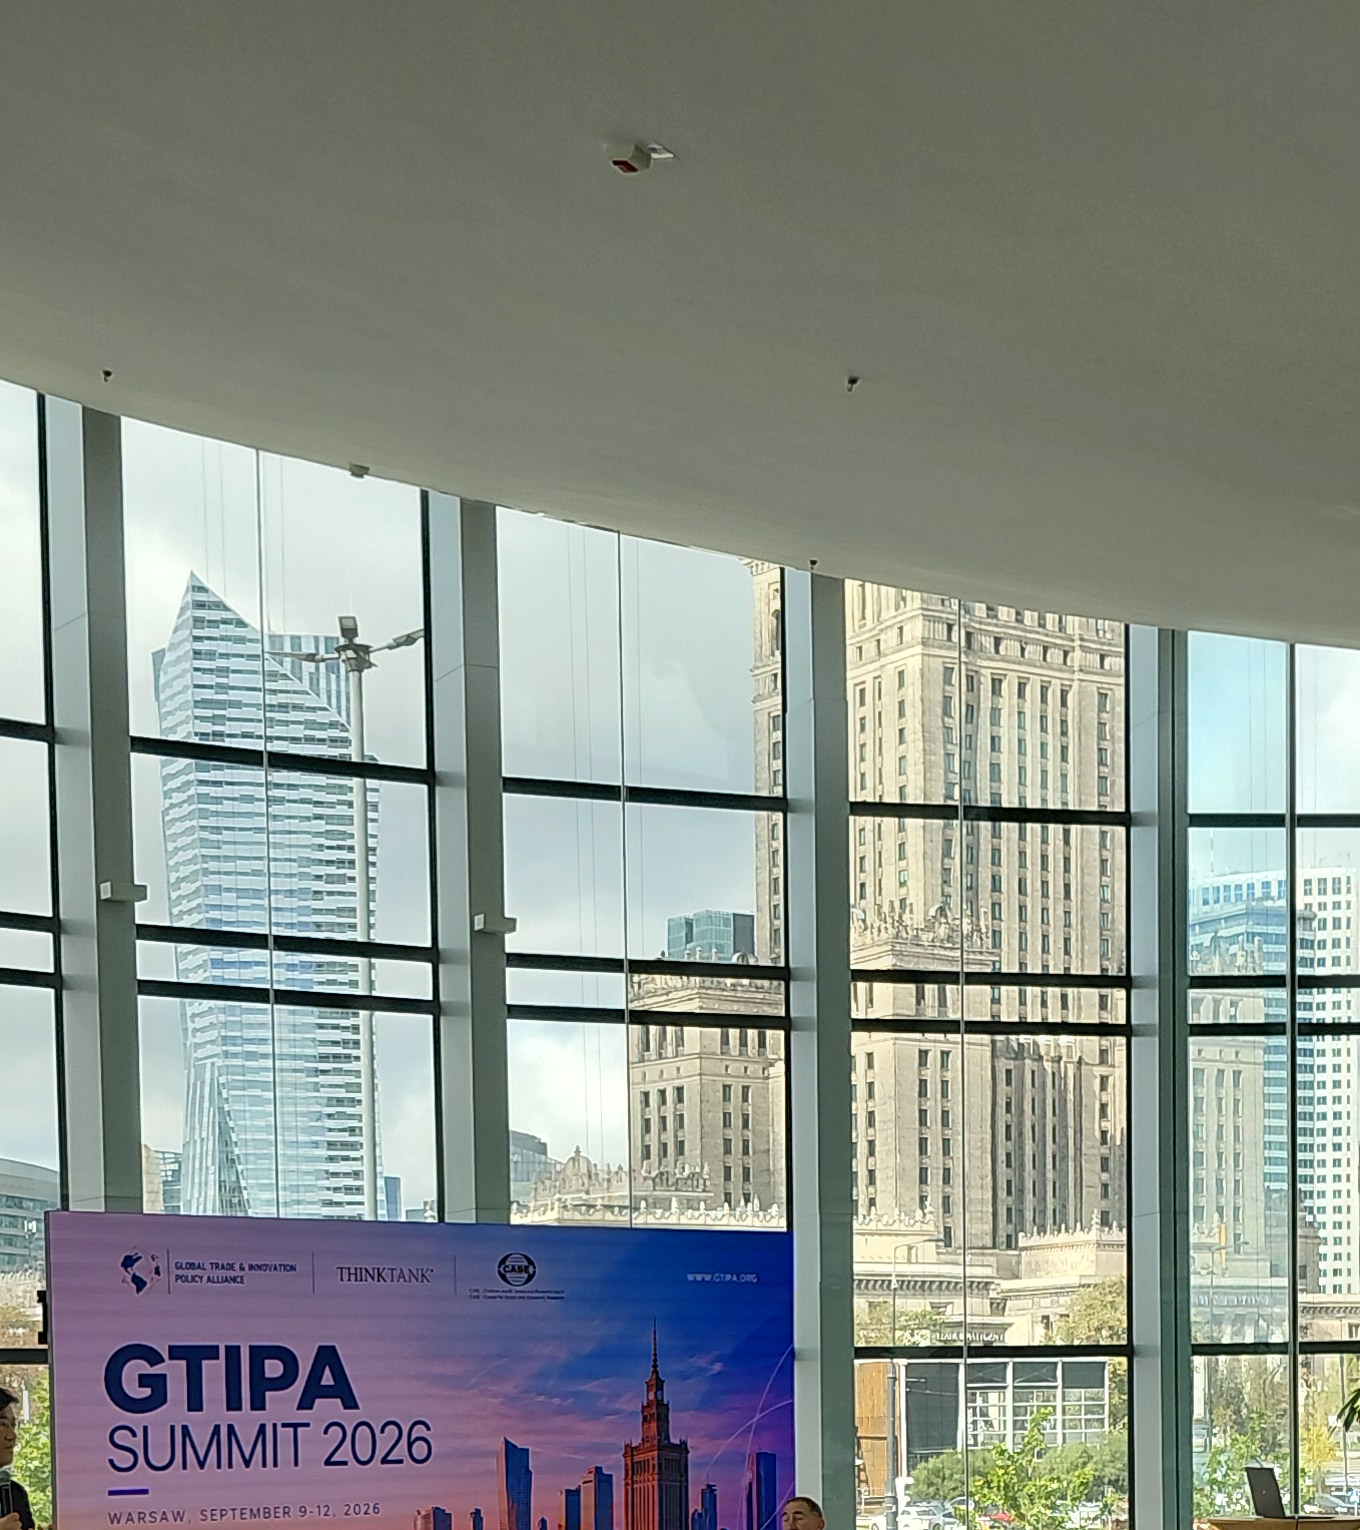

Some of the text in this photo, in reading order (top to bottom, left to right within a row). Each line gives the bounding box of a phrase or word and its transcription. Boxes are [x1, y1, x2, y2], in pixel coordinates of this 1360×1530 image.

[174, 1261, 297, 1273] GLOBAL TRADE & INNOVATION
[174, 1274, 245, 1285] POLICY ALLIANCE
[104, 1343, 361, 1414] GTIPA
[108, 1420, 433, 1473] SUMMIT 2026
[108, 1503, 381, 1526] WARSAW, SEPTEMBER 9-12, 2026
